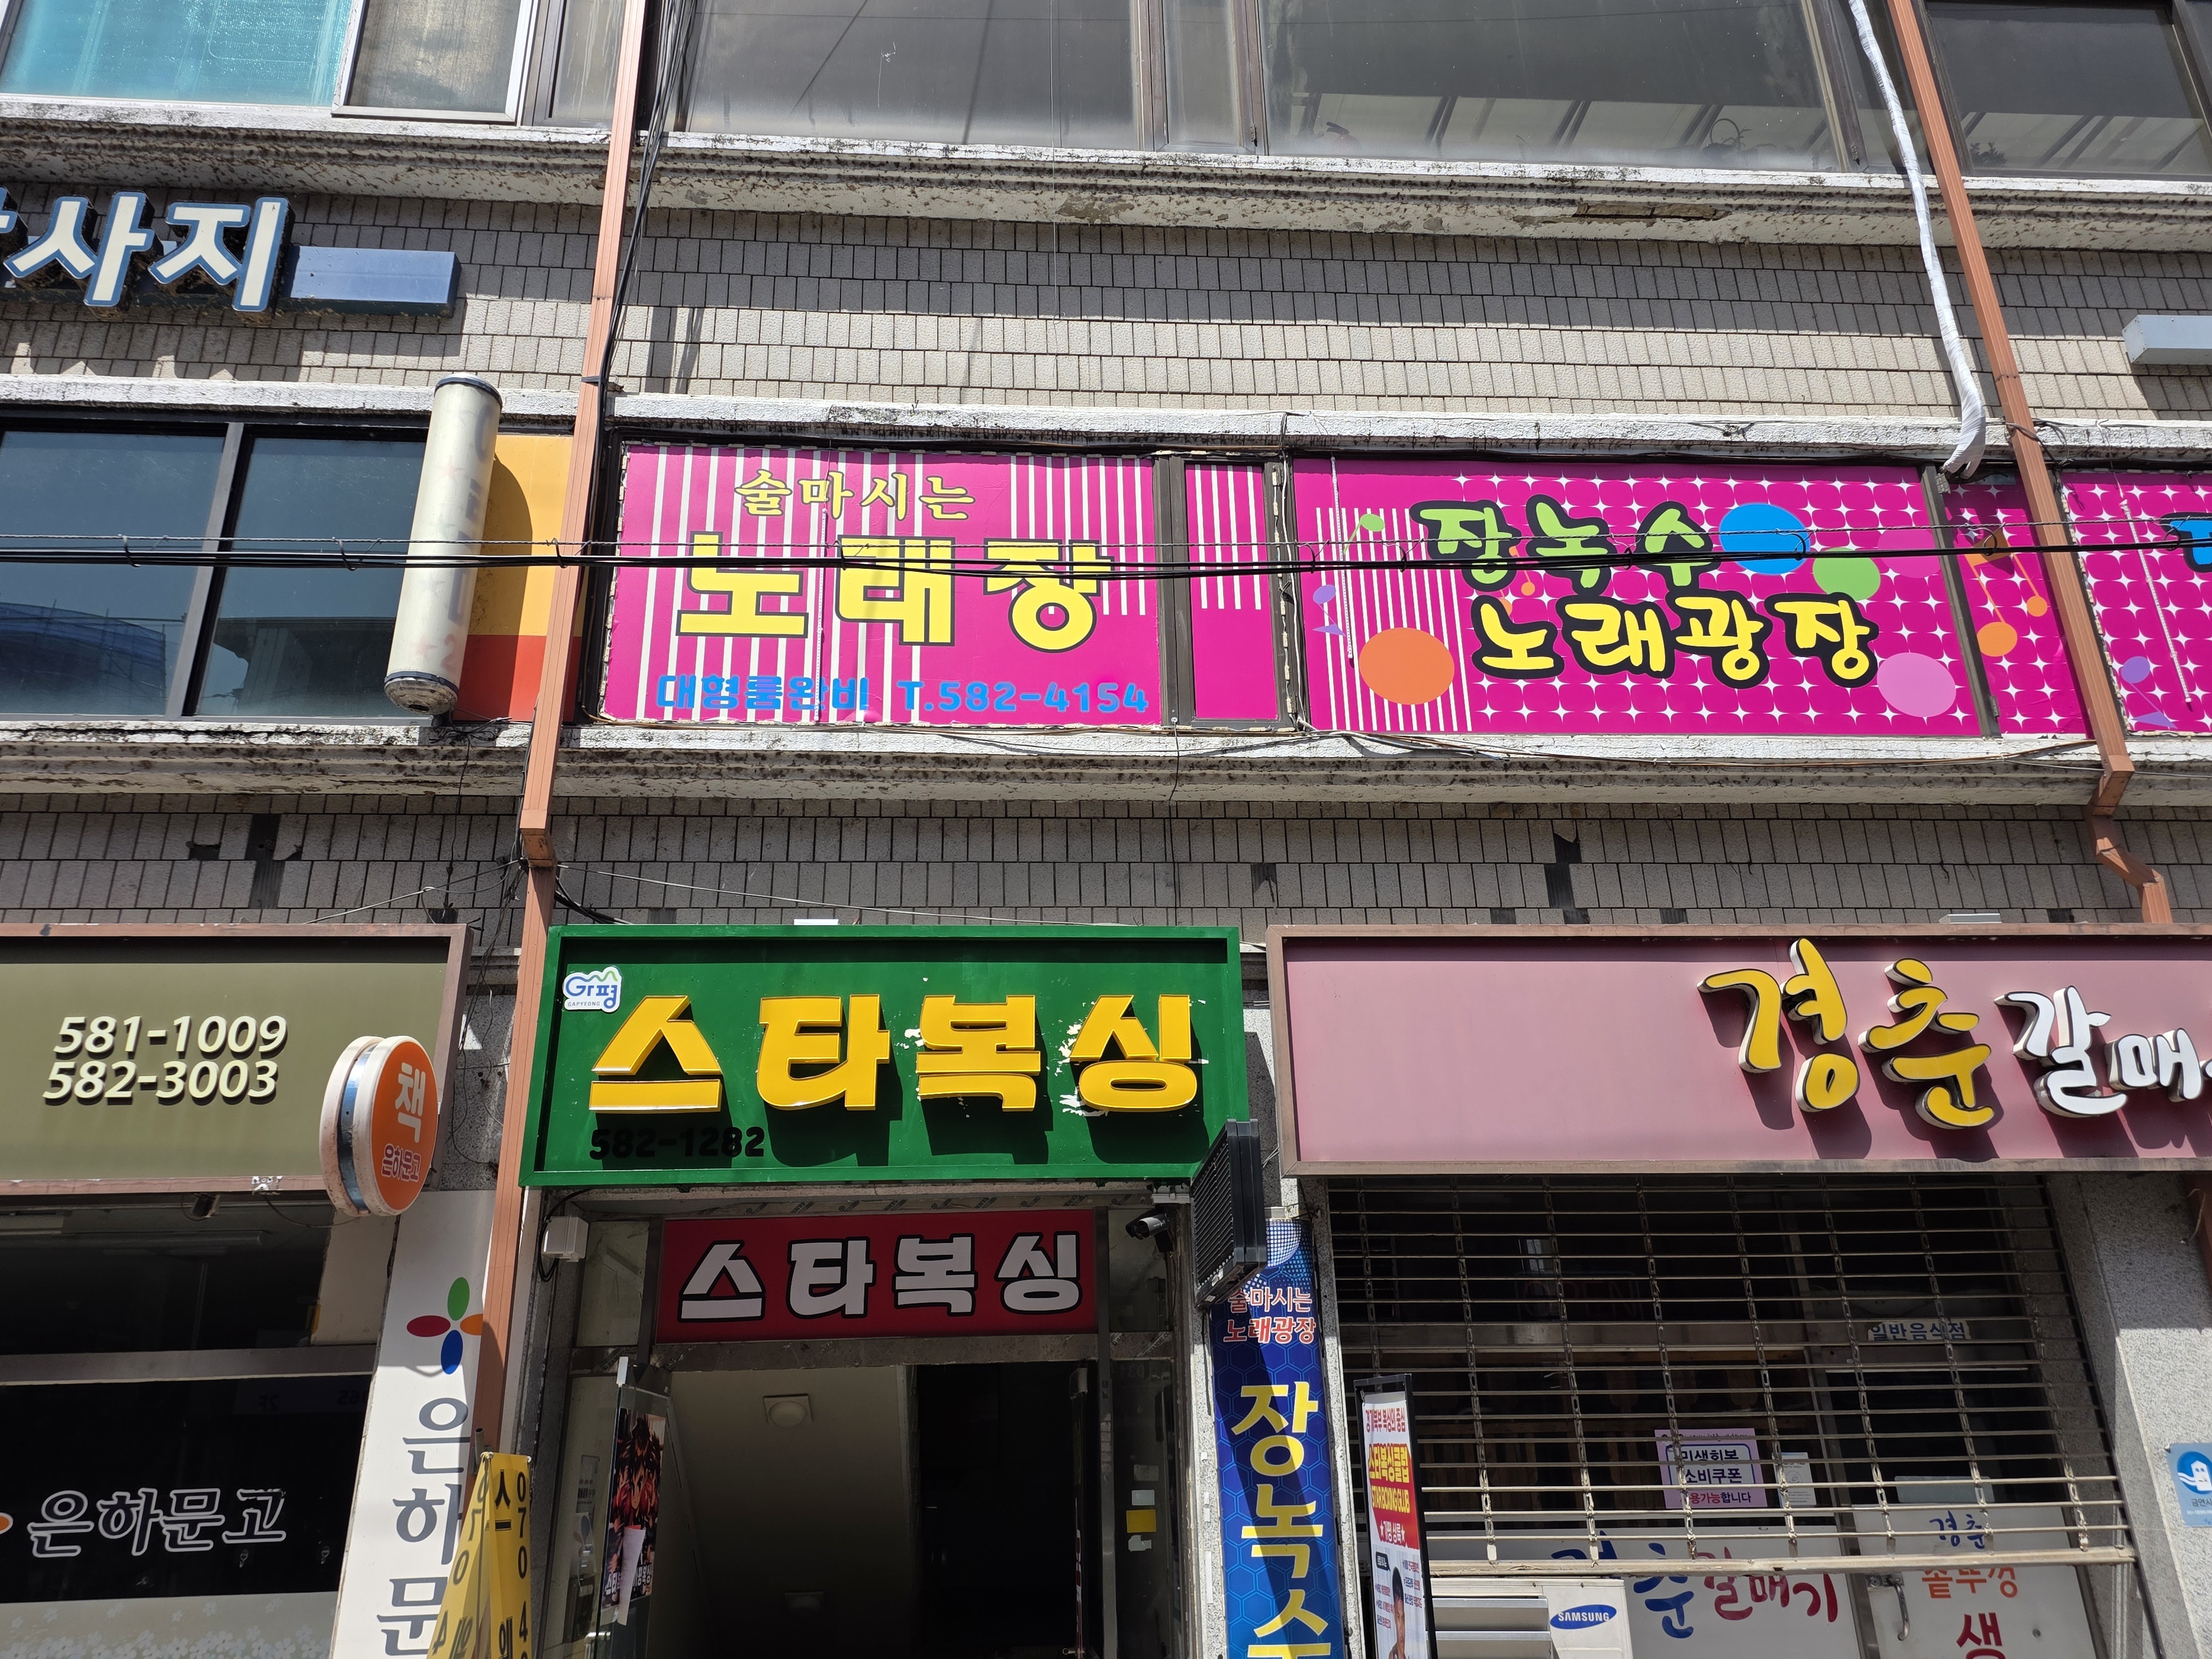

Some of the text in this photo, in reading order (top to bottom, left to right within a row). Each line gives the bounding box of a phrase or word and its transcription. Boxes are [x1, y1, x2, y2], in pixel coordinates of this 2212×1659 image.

[0, 186, 290, 312] 사지
[735, 468, 976, 521] 술마시는
[1409, 494, 1721, 593] 장녹수
[676, 531, 1114, 653] 노래장
[1471, 589, 1878, 688] 노래광장
[656, 674, 1149, 713] 대형룸완비 T.582-4154
[53, 1015, 288, 1056] 581-1009
[588, 994, 1198, 1112] 스타복싱
[1696, 937, 2212, 1129] 경춘 갈매
[42, 1060, 278, 1102] 582-3003
[395, 1062, 426, 1143] 책
[381, 1143, 421, 1182] 은하문고
[589, 1126, 765, 1160] 582-1282
[679, 1231, 1081, 1321] 스타복싱
[1228, 1287, 1312, 1313] 술마시는
[1223, 1316, 1316, 1344] 노래광장
[1871, 1322, 1967, 1341] 일반음식점
[1365, 1407, 1406, 1433] 경기북부 복싱의 중심
[1368, 1443, 1410, 1483] 스타복싱클럽
[1685, 1468, 1743, 1484] 소비쿠폰
[1371, 1485, 1382, 1509] STAR
[1397, 1488, 1410, 1513] CLUB
[1680, 1492, 1751, 1504] 용가능합니다
[28, 1488, 286, 1558] 은하문고
[376, 1397, 471, 1656] 은하문
[1231, 1381, 1331, 1659] 장녹수
[1929, 1510, 1985, 1550] 경춘
[1557, 1611, 1610, 1622] SAMSUNG
